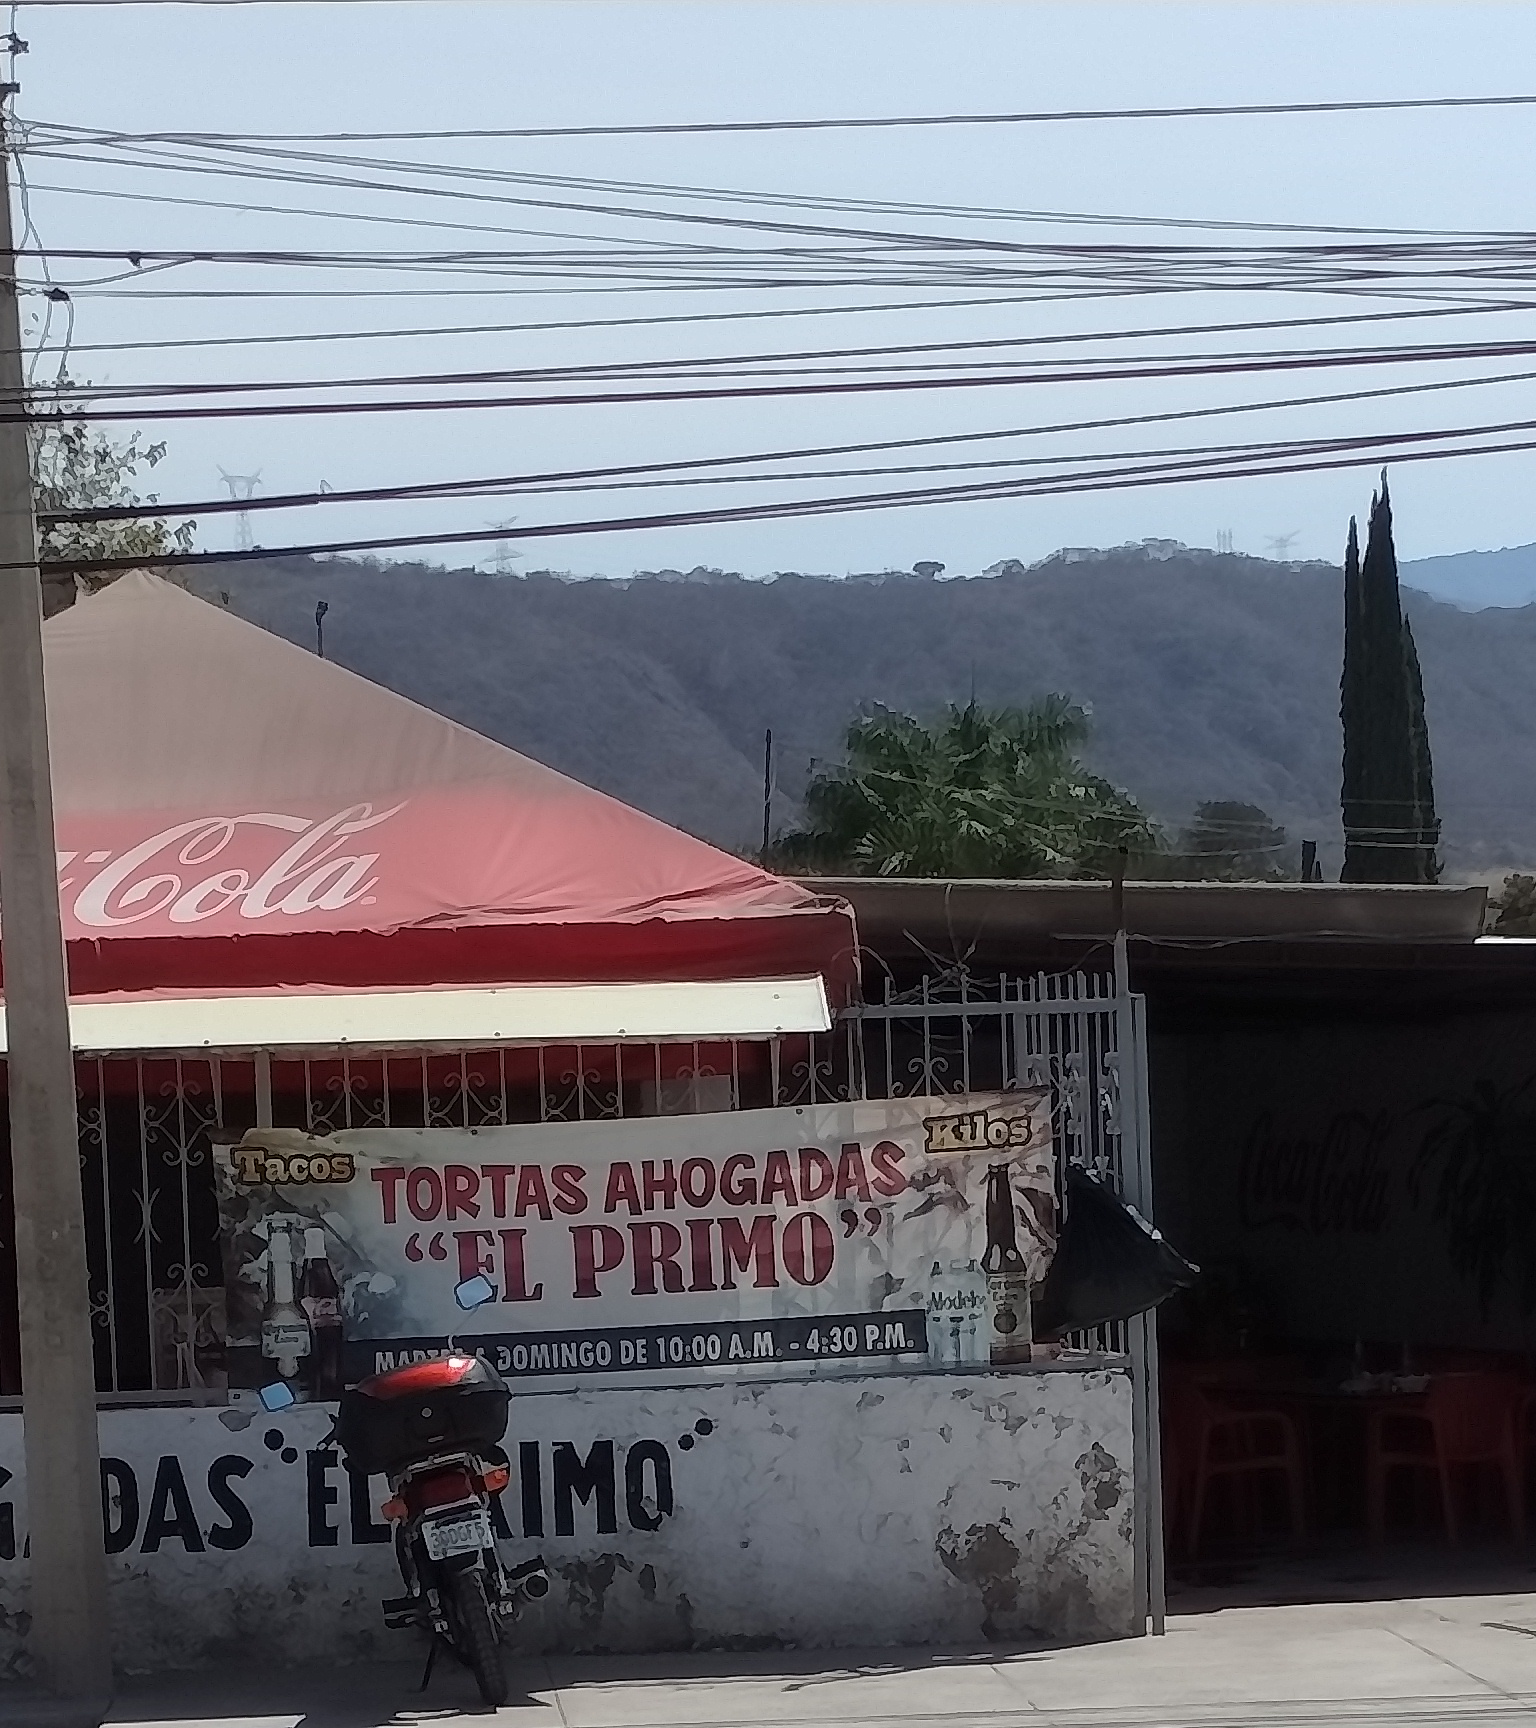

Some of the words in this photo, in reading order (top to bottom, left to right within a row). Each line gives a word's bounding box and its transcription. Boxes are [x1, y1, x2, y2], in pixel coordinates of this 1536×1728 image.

[231, 1147, 356, 1186] Tacos
[924, 1111, 1033, 1153] Kilos
[370, 1163, 588, 1224] TORTAS
[603, 1141, 907, 1216] AHOGADAS
[497, 1339, 613, 1371] DOMINGO
[619, 1338, 648, 1364] DE
[656, 1333, 721, 1363] 10:00
[728, 1331, 783, 1360] A.M.
[806, 1326, 858, 1354] 4:30
[864, 1323, 914, 1350] P.M.
